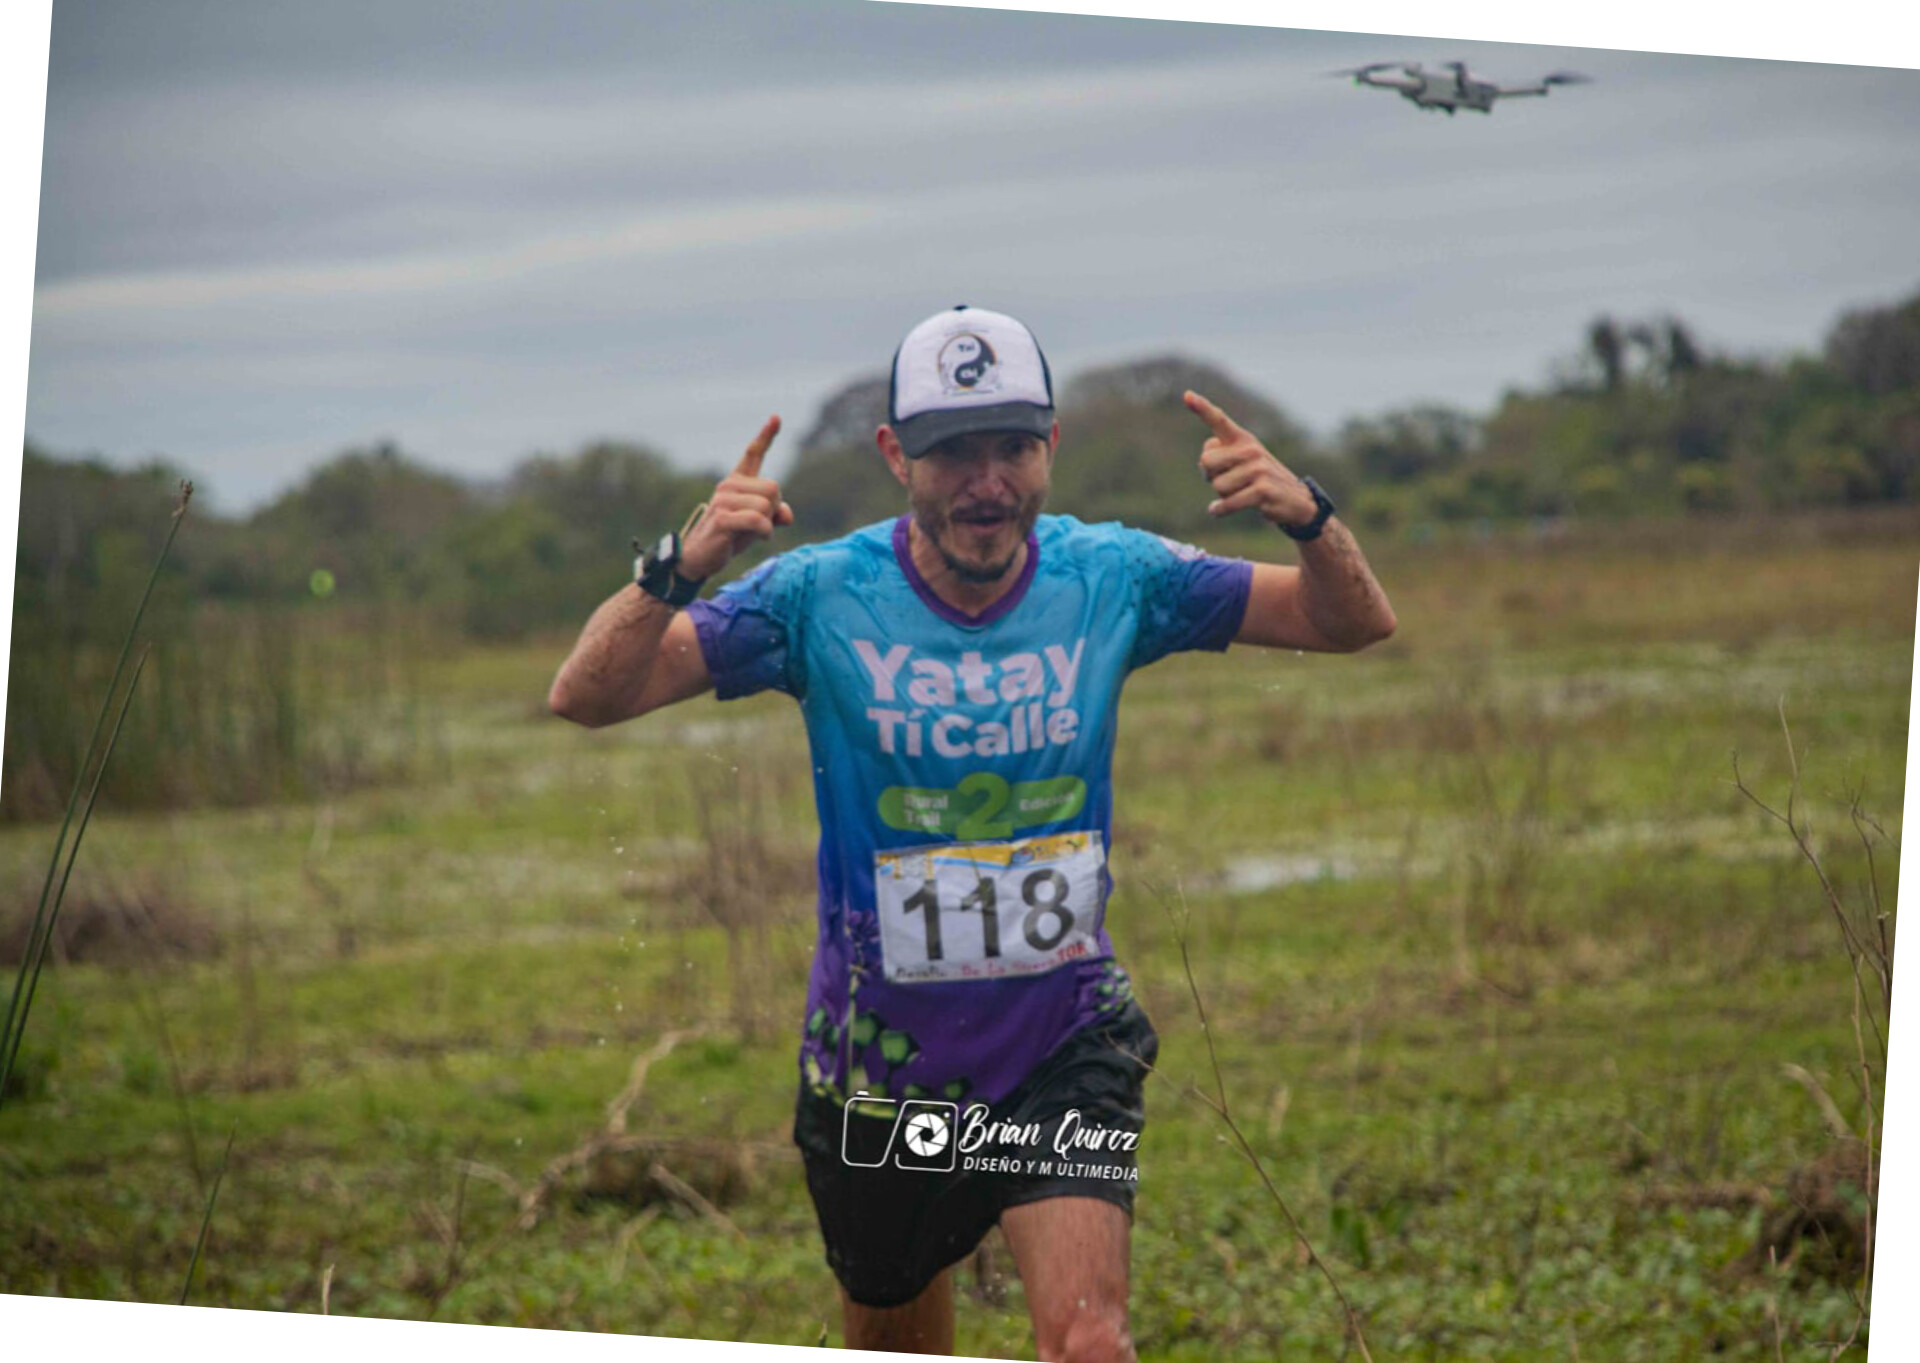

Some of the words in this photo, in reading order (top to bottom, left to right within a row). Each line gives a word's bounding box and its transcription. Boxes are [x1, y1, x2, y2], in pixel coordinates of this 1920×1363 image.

[853, 638, 1085, 707] Yatay
[866, 707, 927, 756] Tí
[931, 702, 1080, 758] Calle
[955, 771, 1014, 841] 2
[903, 868, 1075, 961] 118
